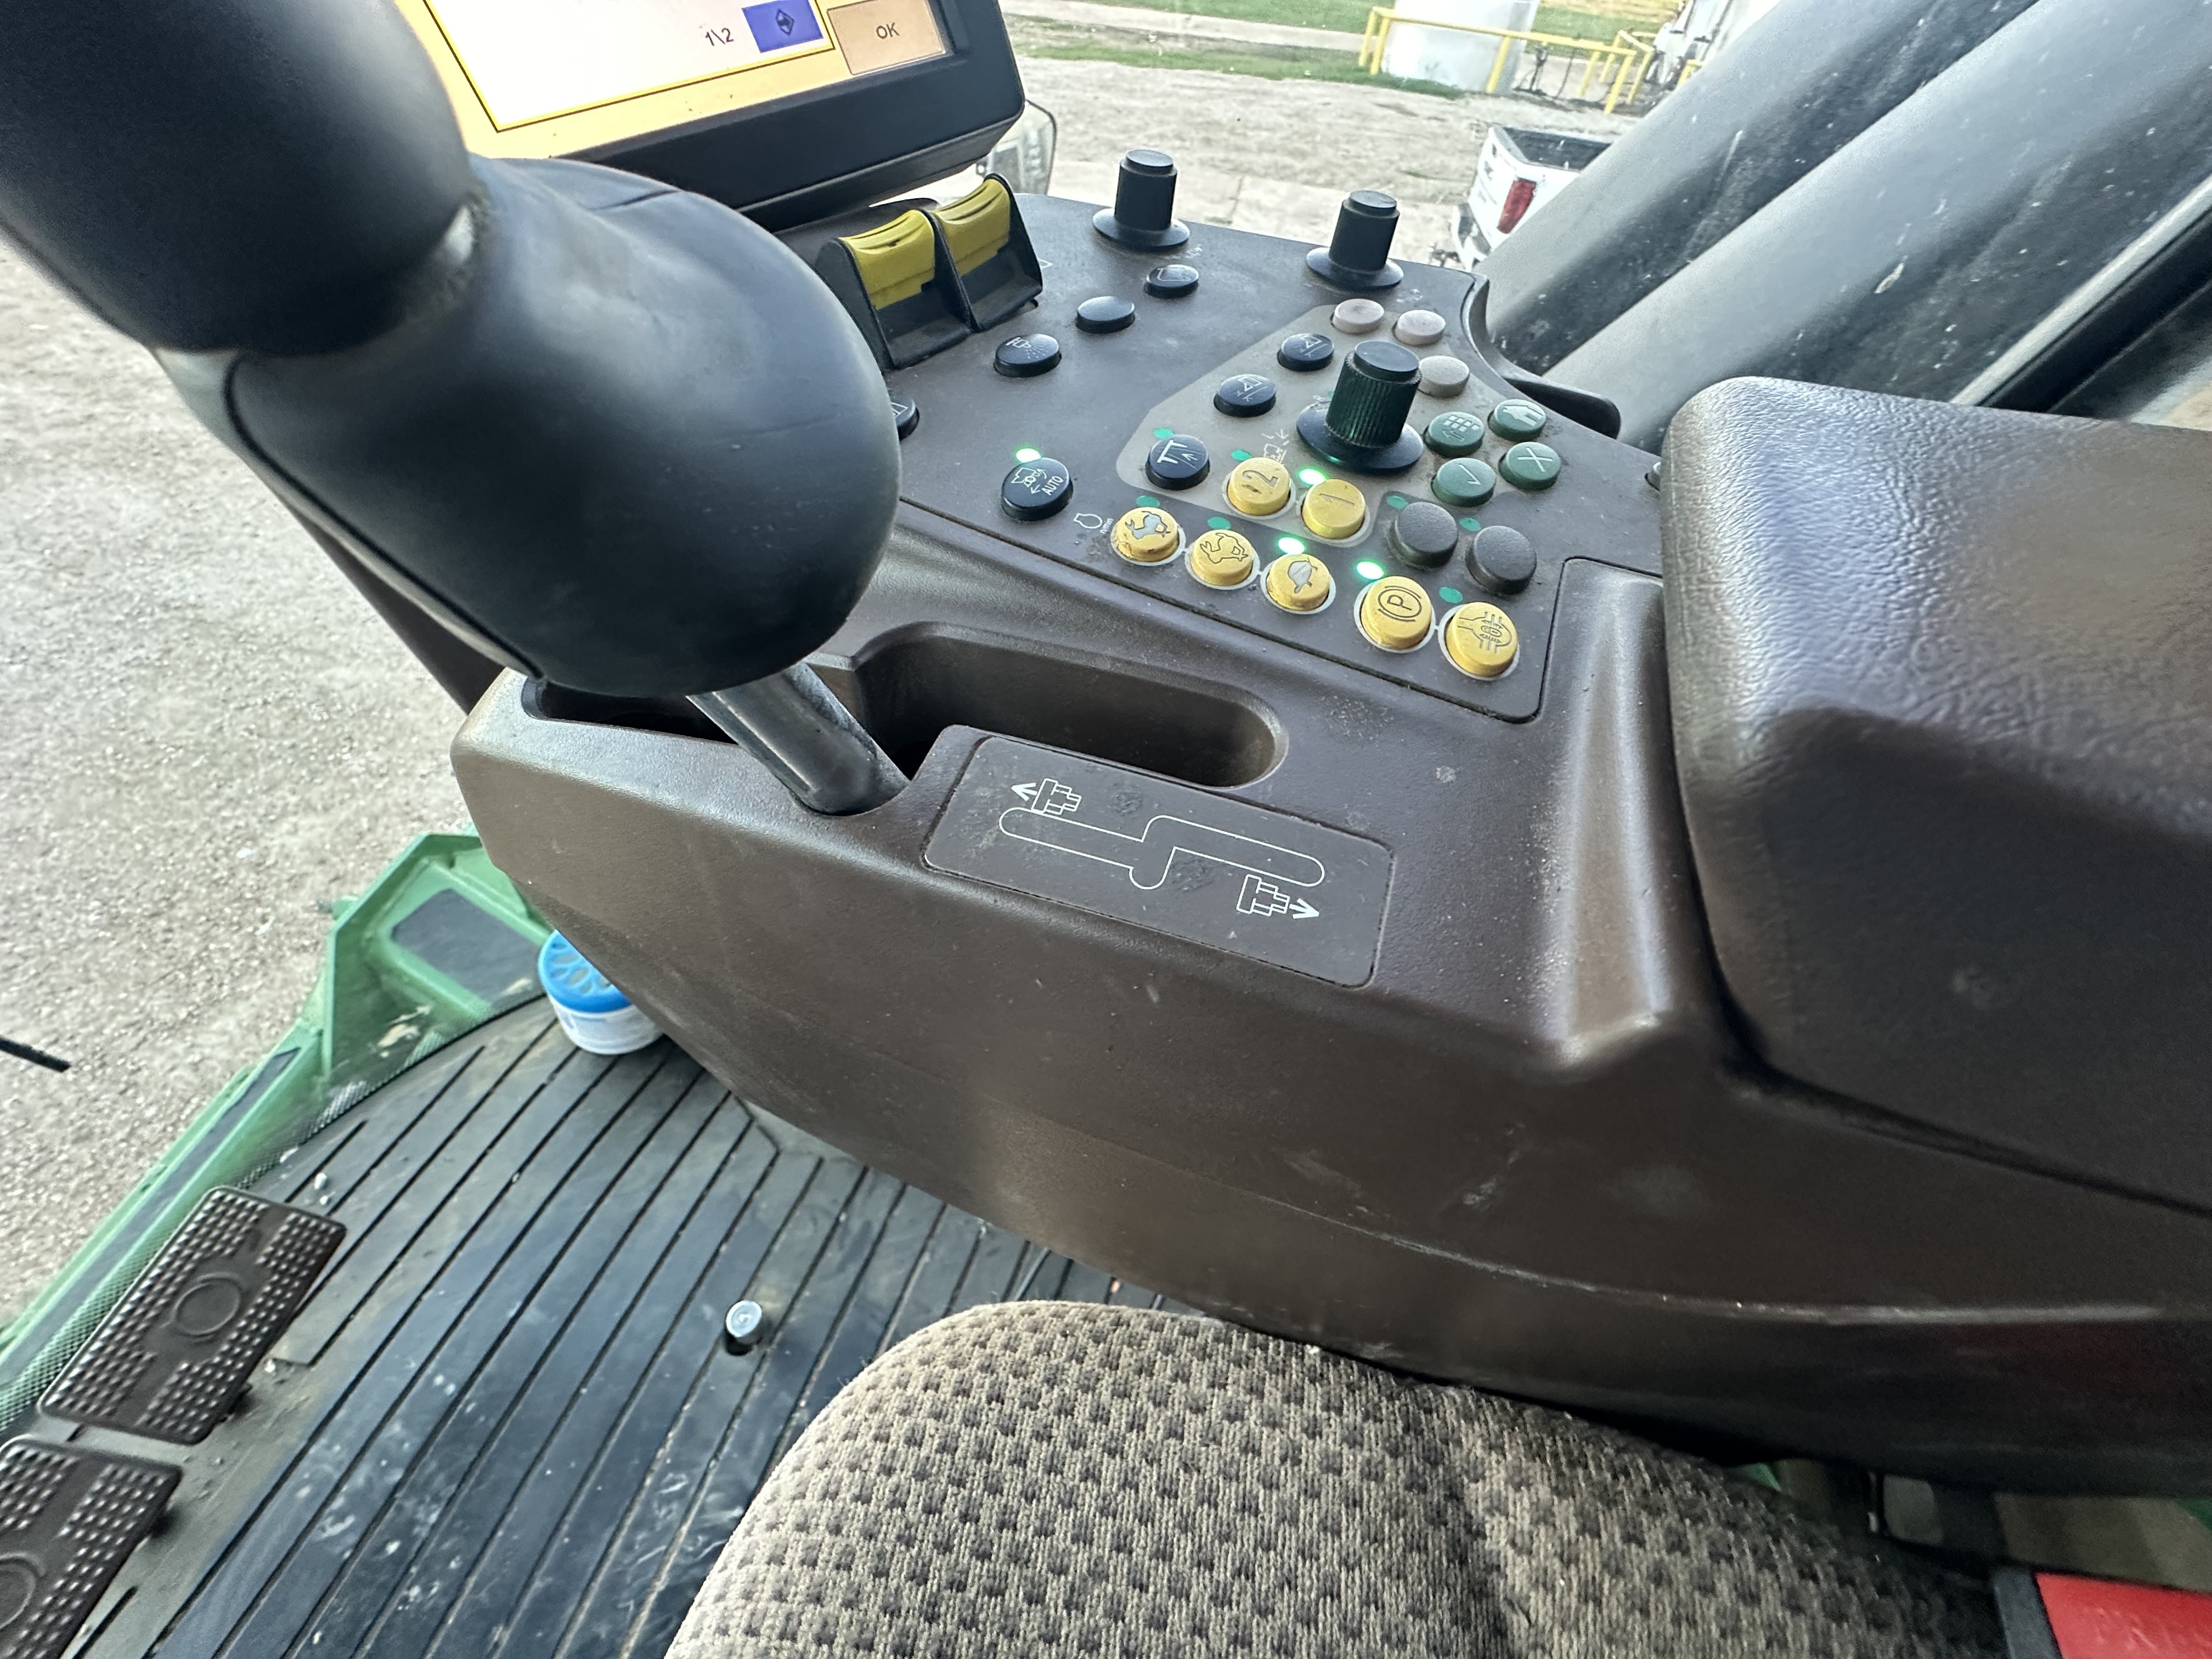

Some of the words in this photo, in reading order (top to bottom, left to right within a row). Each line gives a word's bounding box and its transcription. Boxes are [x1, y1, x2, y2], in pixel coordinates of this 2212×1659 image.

[876, 22, 900, 40] OK
[1041, 475, 1064, 496] AUTO
[1242, 470, 1279, 489] 2
[1318, 493, 1356, 507] 1
